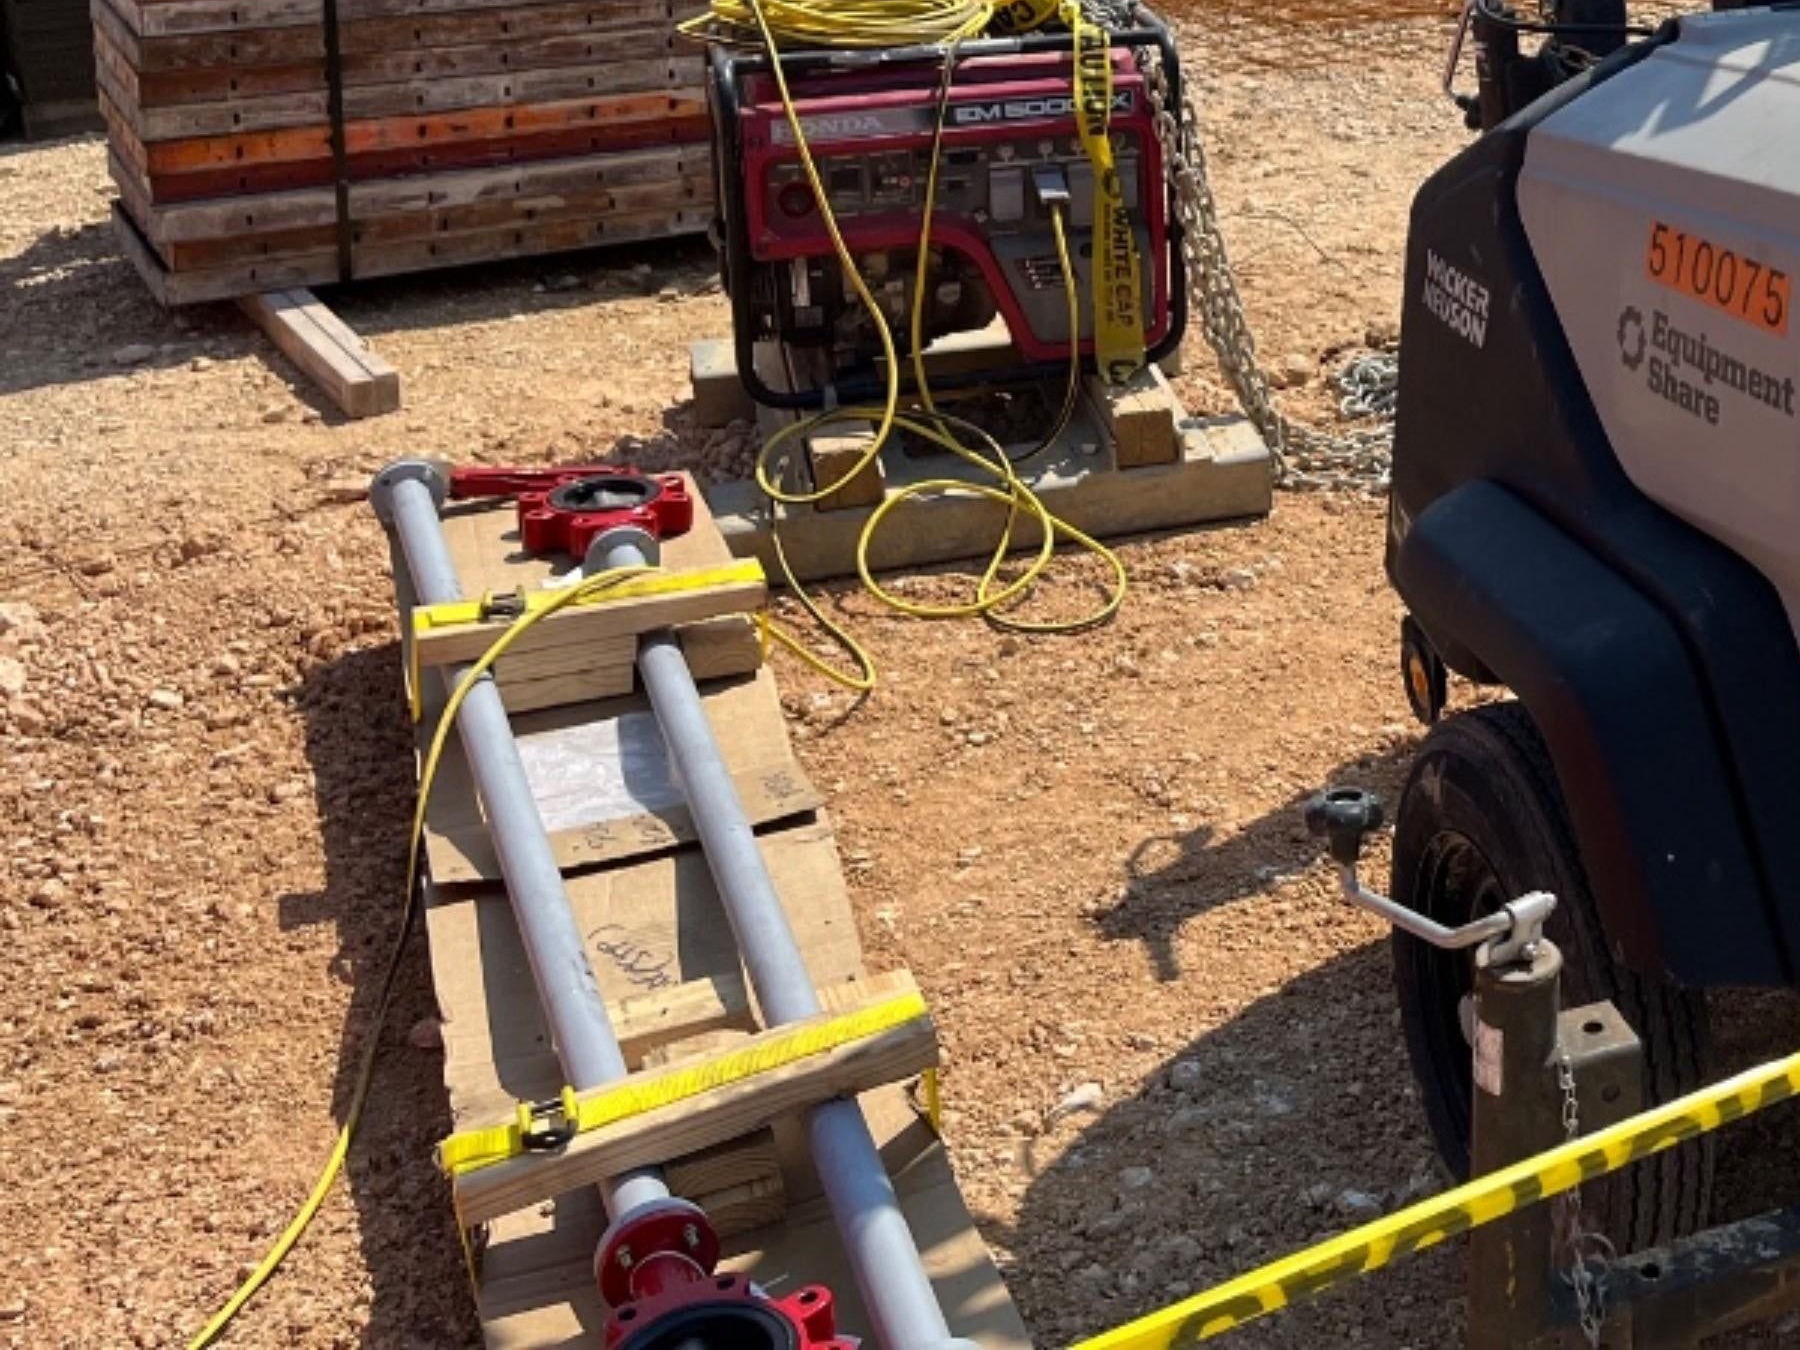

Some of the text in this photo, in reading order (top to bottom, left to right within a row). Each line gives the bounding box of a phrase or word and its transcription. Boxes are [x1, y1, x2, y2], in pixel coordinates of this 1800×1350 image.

[1078, 35, 1107, 136] AUTION
[1421, 269, 1487, 349] NEUSON
[1426, 249, 1489, 313] WACKER
[1648, 224, 1787, 327] 510075
[1647, 353, 1720, 424] Share
[1649, 311, 1796, 417] Equipment
